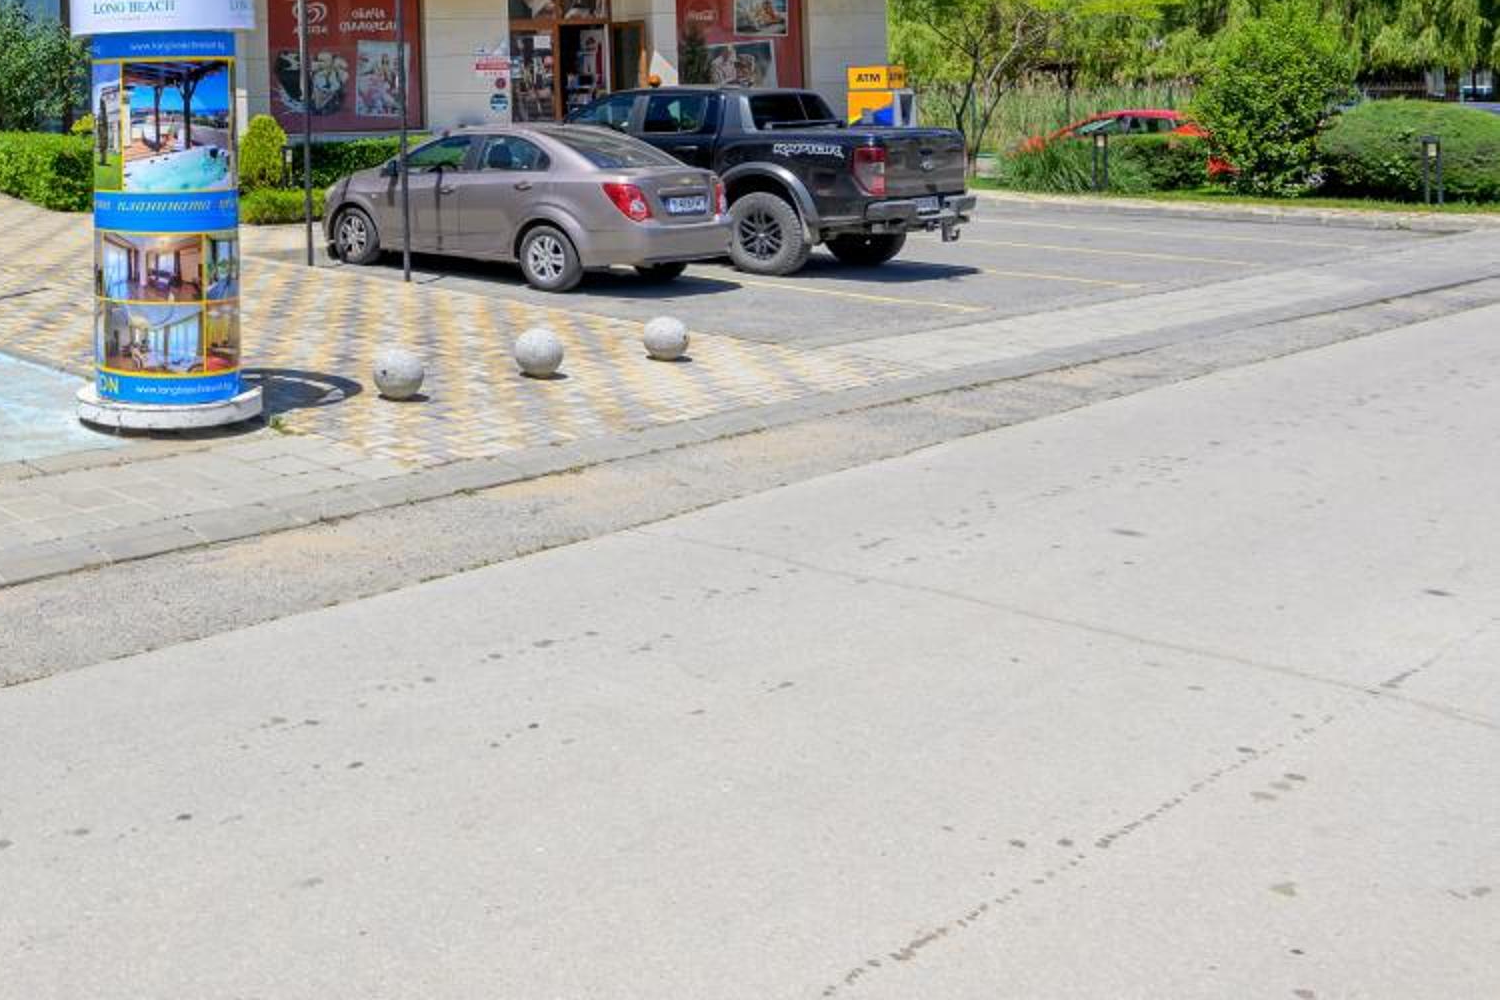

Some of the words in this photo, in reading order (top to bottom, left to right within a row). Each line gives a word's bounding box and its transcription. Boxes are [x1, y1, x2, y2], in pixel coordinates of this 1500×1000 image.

[93, 1, 126, 14] LONG
[128, 0, 175, 13] BEACH
[856, 73, 881, 82] ATM
